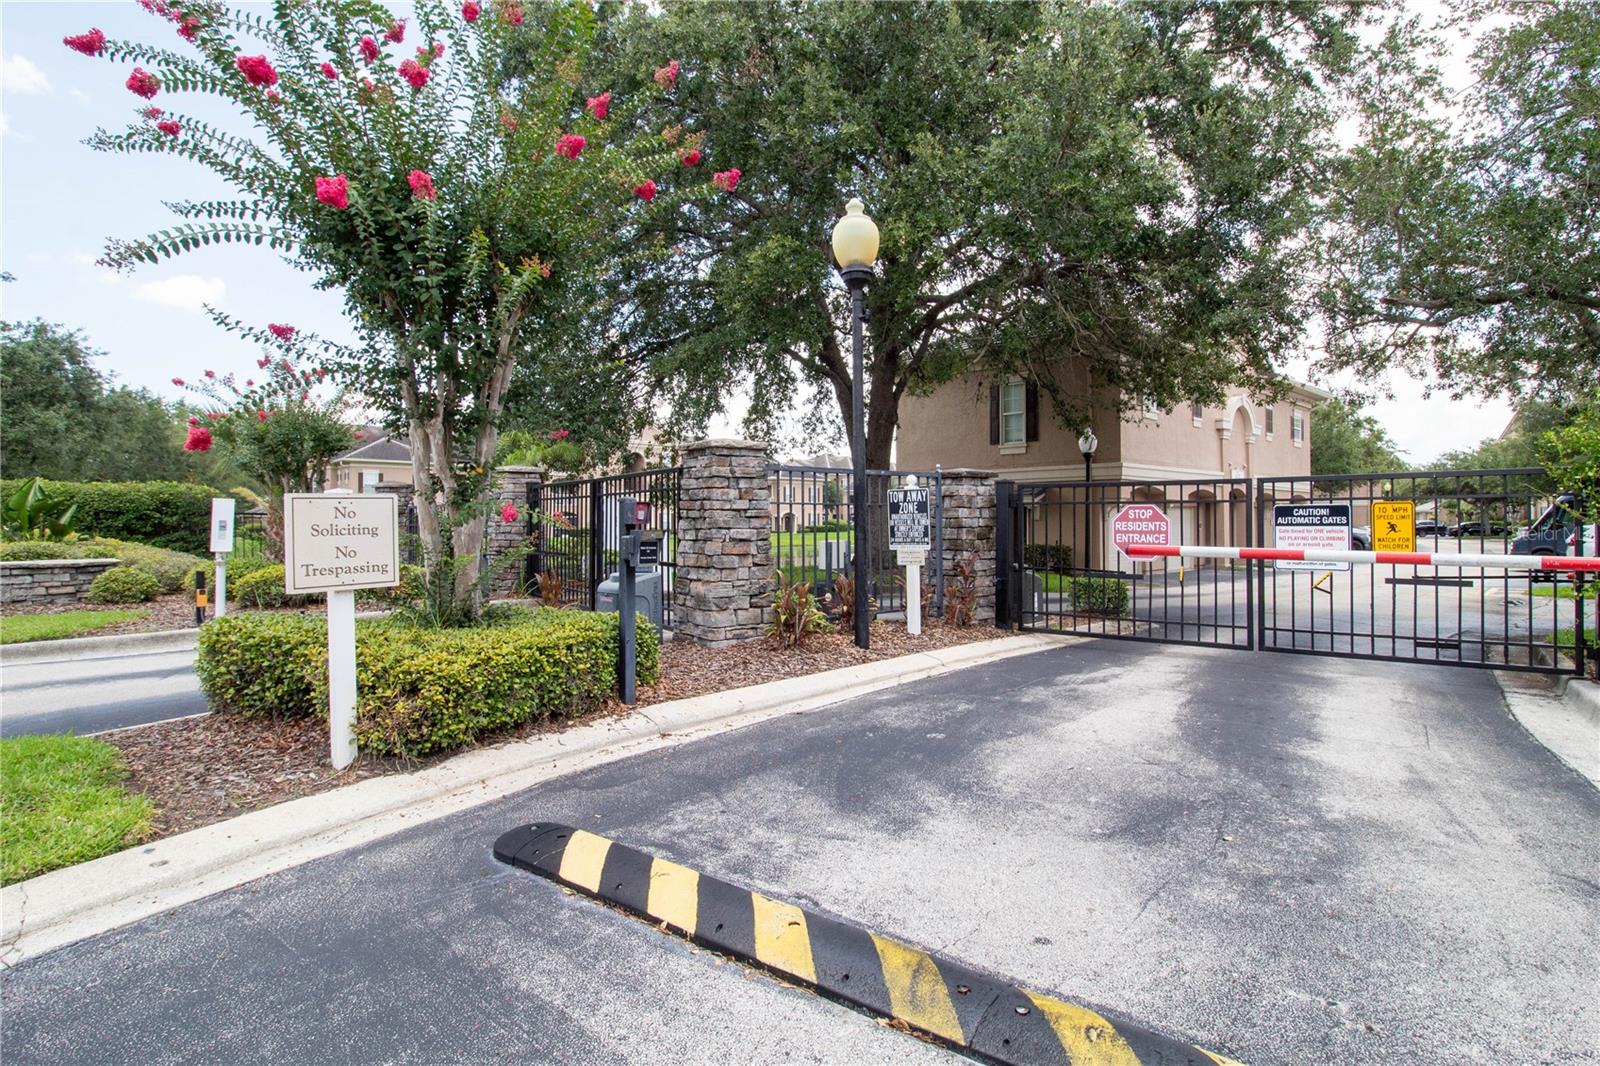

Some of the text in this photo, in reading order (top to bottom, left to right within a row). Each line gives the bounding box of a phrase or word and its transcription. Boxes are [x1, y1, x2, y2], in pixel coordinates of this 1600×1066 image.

[890, 490, 927, 503] TOW AWAY
[334, 506, 356, 519] No
[899, 502, 918, 513] ZONE
[1293, 508, 1329, 516] CAUTION!
[1128, 510, 1153, 519] STOP
[1277, 516, 1347, 524] AUTOMATIC GATES
[311, 524, 379, 537] Soliciting
[1115, 522, 1166, 531] RESIDENTS
[1116, 534, 1166, 543] ENTRANCE
[335, 545, 357, 559] No
[301, 561, 389, 578] Trespassing
